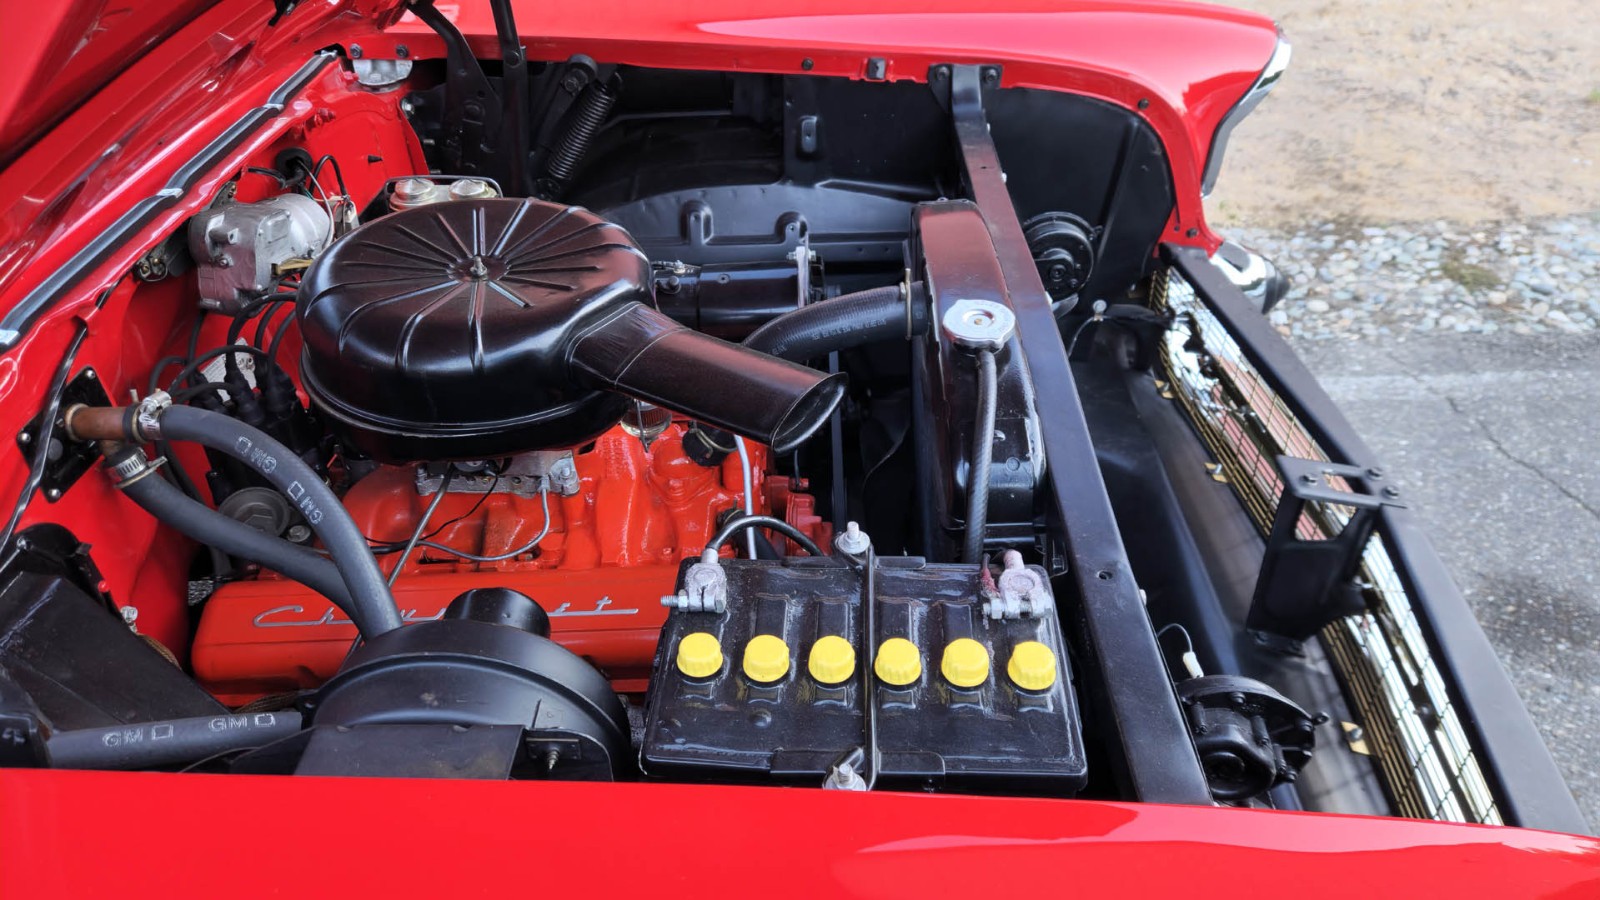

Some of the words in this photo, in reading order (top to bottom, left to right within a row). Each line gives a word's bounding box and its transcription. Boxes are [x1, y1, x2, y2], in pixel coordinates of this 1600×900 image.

[250, 447, 276, 473] GM
[300, 497, 323, 525] GM
[102, 728, 144, 747] GM
[208, 716, 248, 732] GM
